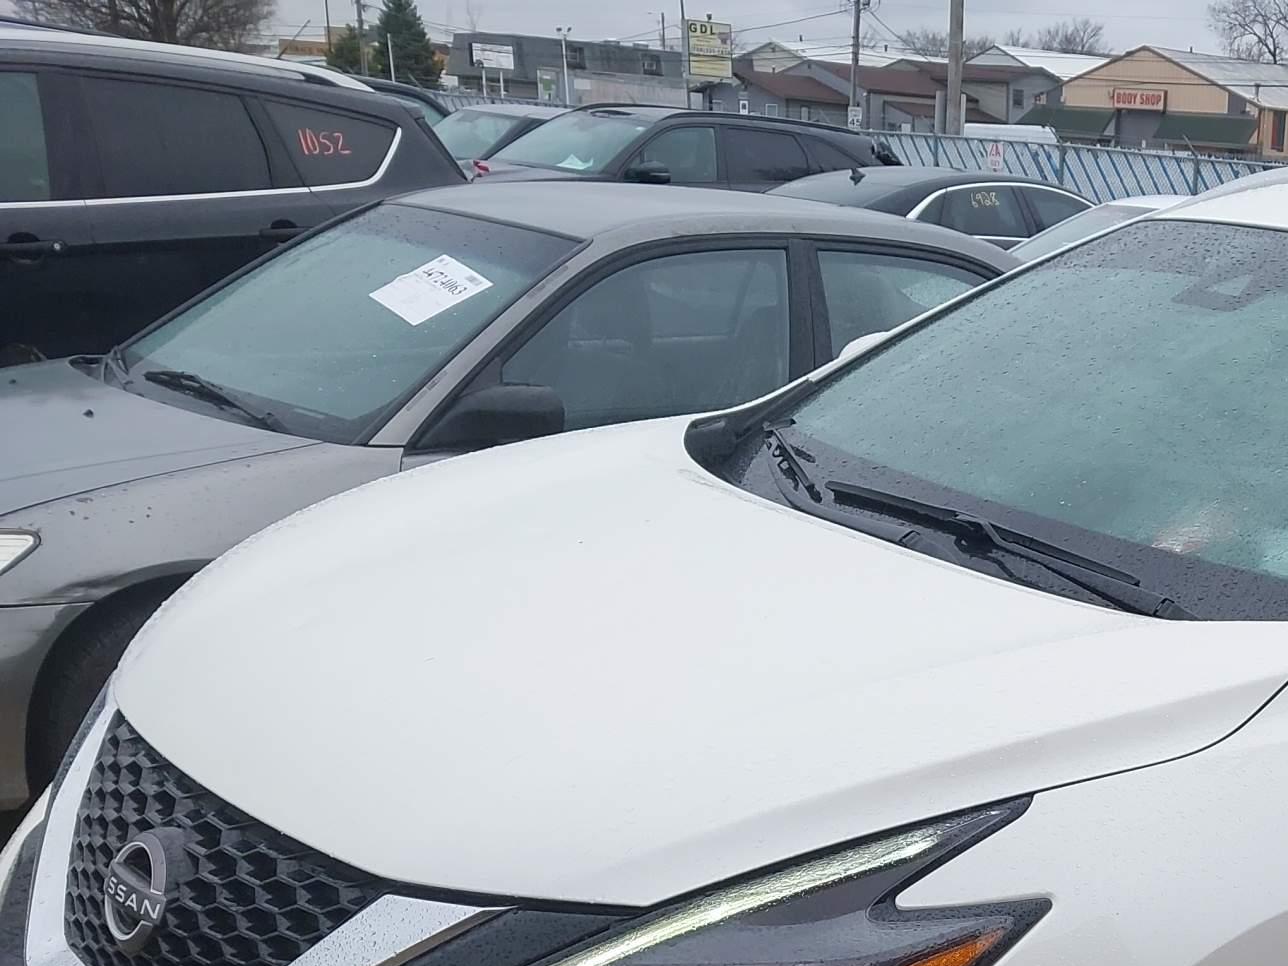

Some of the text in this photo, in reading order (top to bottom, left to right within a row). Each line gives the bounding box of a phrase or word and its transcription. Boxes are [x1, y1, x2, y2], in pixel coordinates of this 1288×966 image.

[690, 23, 715, 36] GDL
[1116, 92, 1161, 105] BODY SHOP
[849, 118, 861, 127] 45
[298, 128, 352, 155] 1052
[107, 876, 161, 919] SSAN
